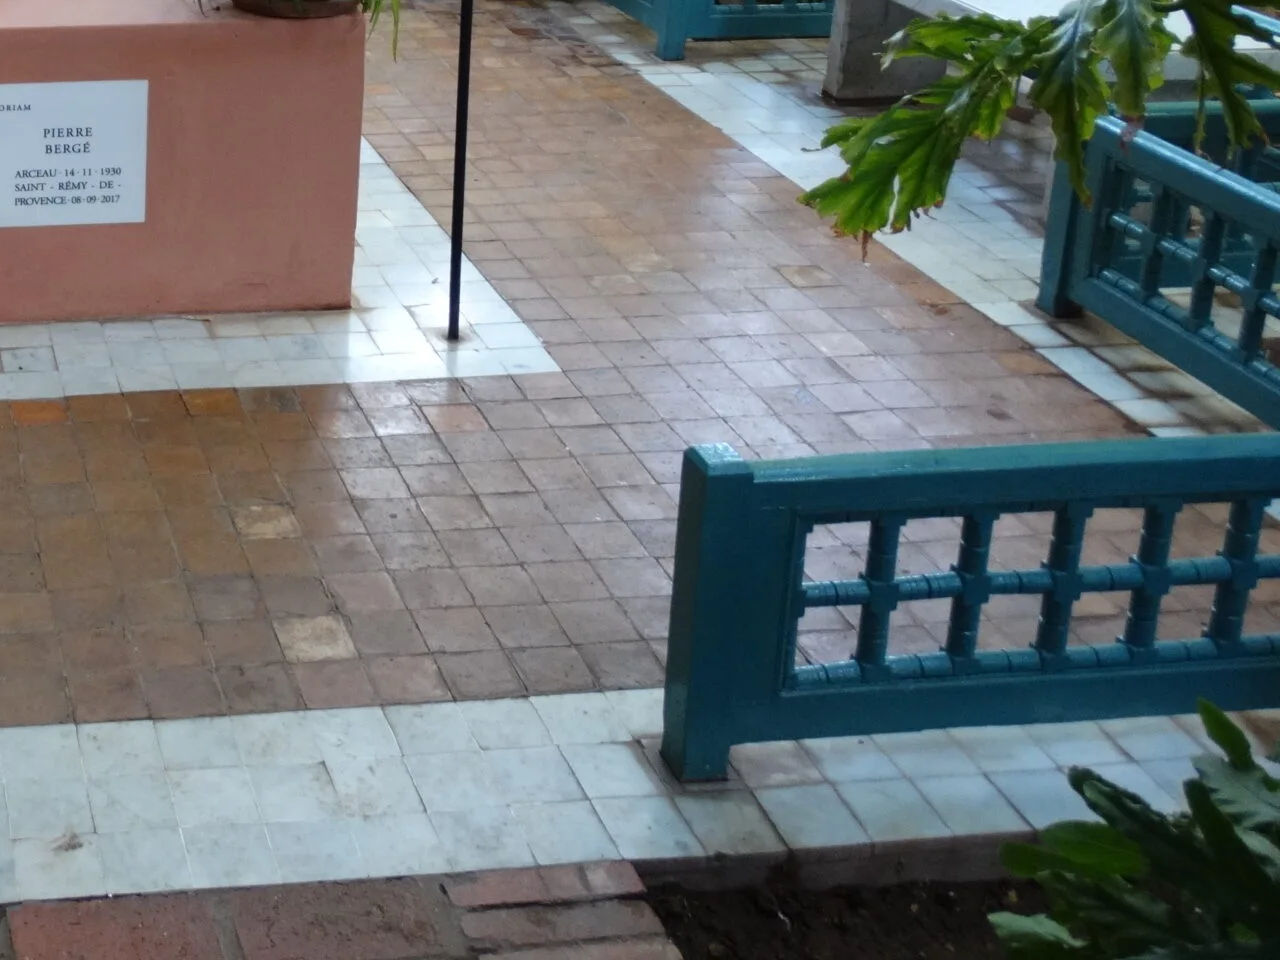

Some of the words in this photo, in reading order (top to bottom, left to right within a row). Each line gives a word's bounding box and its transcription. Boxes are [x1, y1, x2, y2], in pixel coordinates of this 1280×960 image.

[43, 126, 93, 139] PIERRE
[44, 141, 91, 155] BERGÉ
[14, 168, 57, 179] ARCEAU
[64, 168, 76, 177] 14
[82, 168, 92, 177] 11
[100, 167, 122, 176] 1930
[14, 182, 47, 192] SAINT
[58, 180, 88, 191] RÉMY
